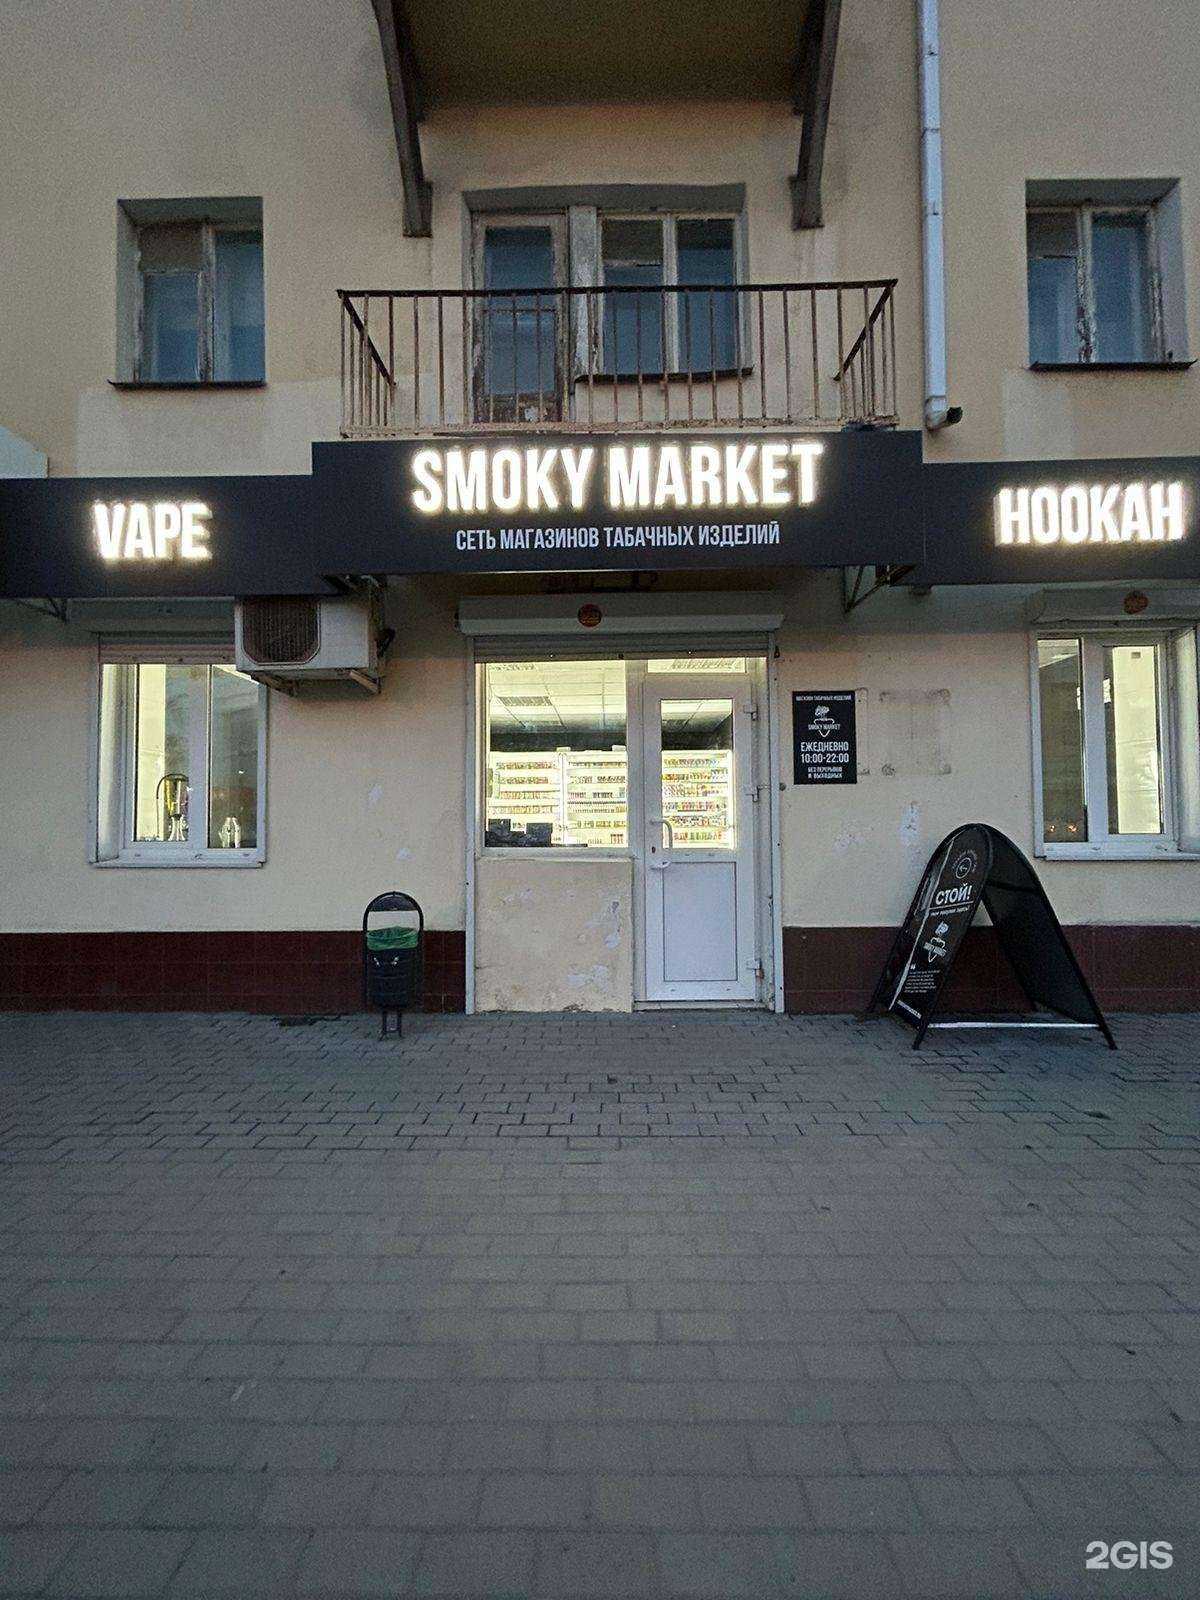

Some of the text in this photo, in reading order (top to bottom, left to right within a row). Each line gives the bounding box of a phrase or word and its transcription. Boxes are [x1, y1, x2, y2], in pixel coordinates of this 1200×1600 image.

[411, 440, 824, 513] SMOKY MARKET
[993, 480, 1187, 548] HOOKAH
[92, 499, 213, 561] VAPE
[455, 520, 781, 551] СЕТЬ МАГАЗИНОВ ТАБАЧНЫХ ИЗДЕЛИЙ
[800, 741, 849, 752] ЕЖЕДНЕВНО
[800, 753, 850, 763] 10:00-22:00
[935, 882, 973, 905] СТОЙ!
